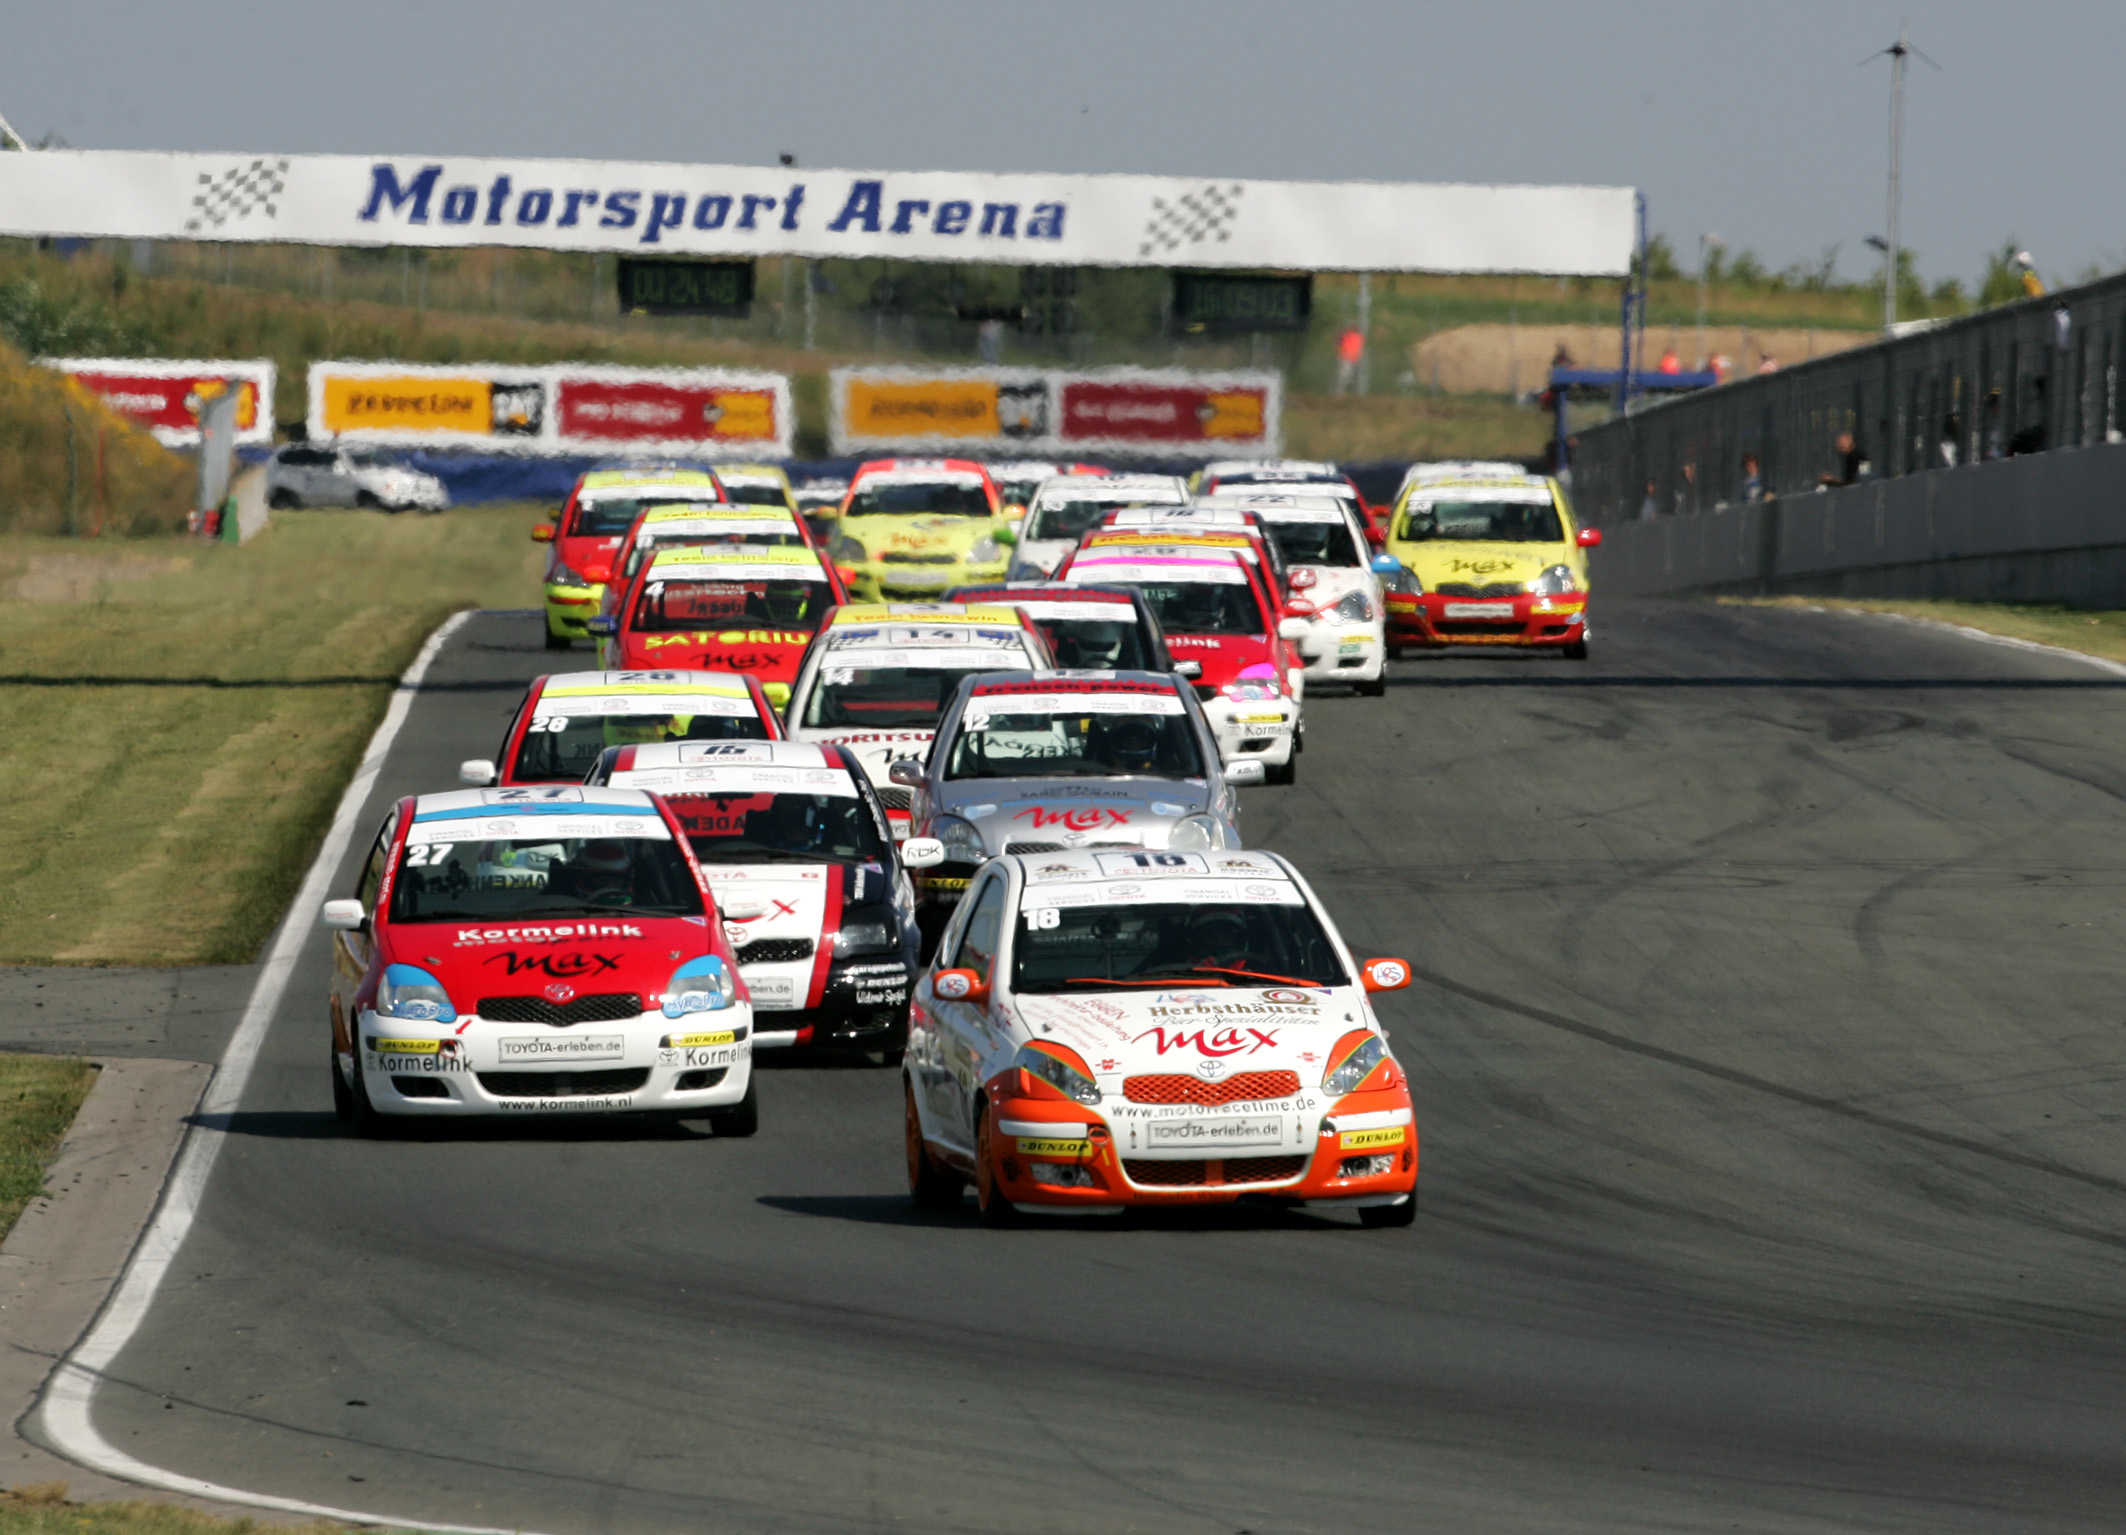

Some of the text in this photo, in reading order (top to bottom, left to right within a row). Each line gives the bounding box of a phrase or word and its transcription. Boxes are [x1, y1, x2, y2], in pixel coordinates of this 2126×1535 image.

[358, 165, 1067, 244] Motorsport Arena
[644, 630, 810, 650] SATORIU
[963, 713, 990, 732] 12
[1244, 723, 1292, 737] Kormelin
[1011, 806, 1135, 832] max
[406, 843, 454, 868] 27
[1022, 907, 1061, 931] 18
[457, 924, 644, 941] Kormelink
[482, 951, 625, 978] max
[1148, 1003, 1322, 1017] Herbsthäuser
[1205, 1012, 1320, 1028] Spezialitäten
[383, 1040, 436, 1050] DUNLOP
[684, 1034, 732, 1043] DUNLOP
[1130, 1026, 1282, 1058] max
[504, 1041, 622, 1054] TOYOTA-erleben.de
[379, 1054, 475, 1072] Kormelink
[498, 1096, 633, 1111] www.kormelink.nl
[1154, 1124, 1279, 1138] TOYOTA-erleben.de
[1355, 1131, 1404, 1145] DUNLOP
[1027, 1141, 1090, 1153] DUNLOP
